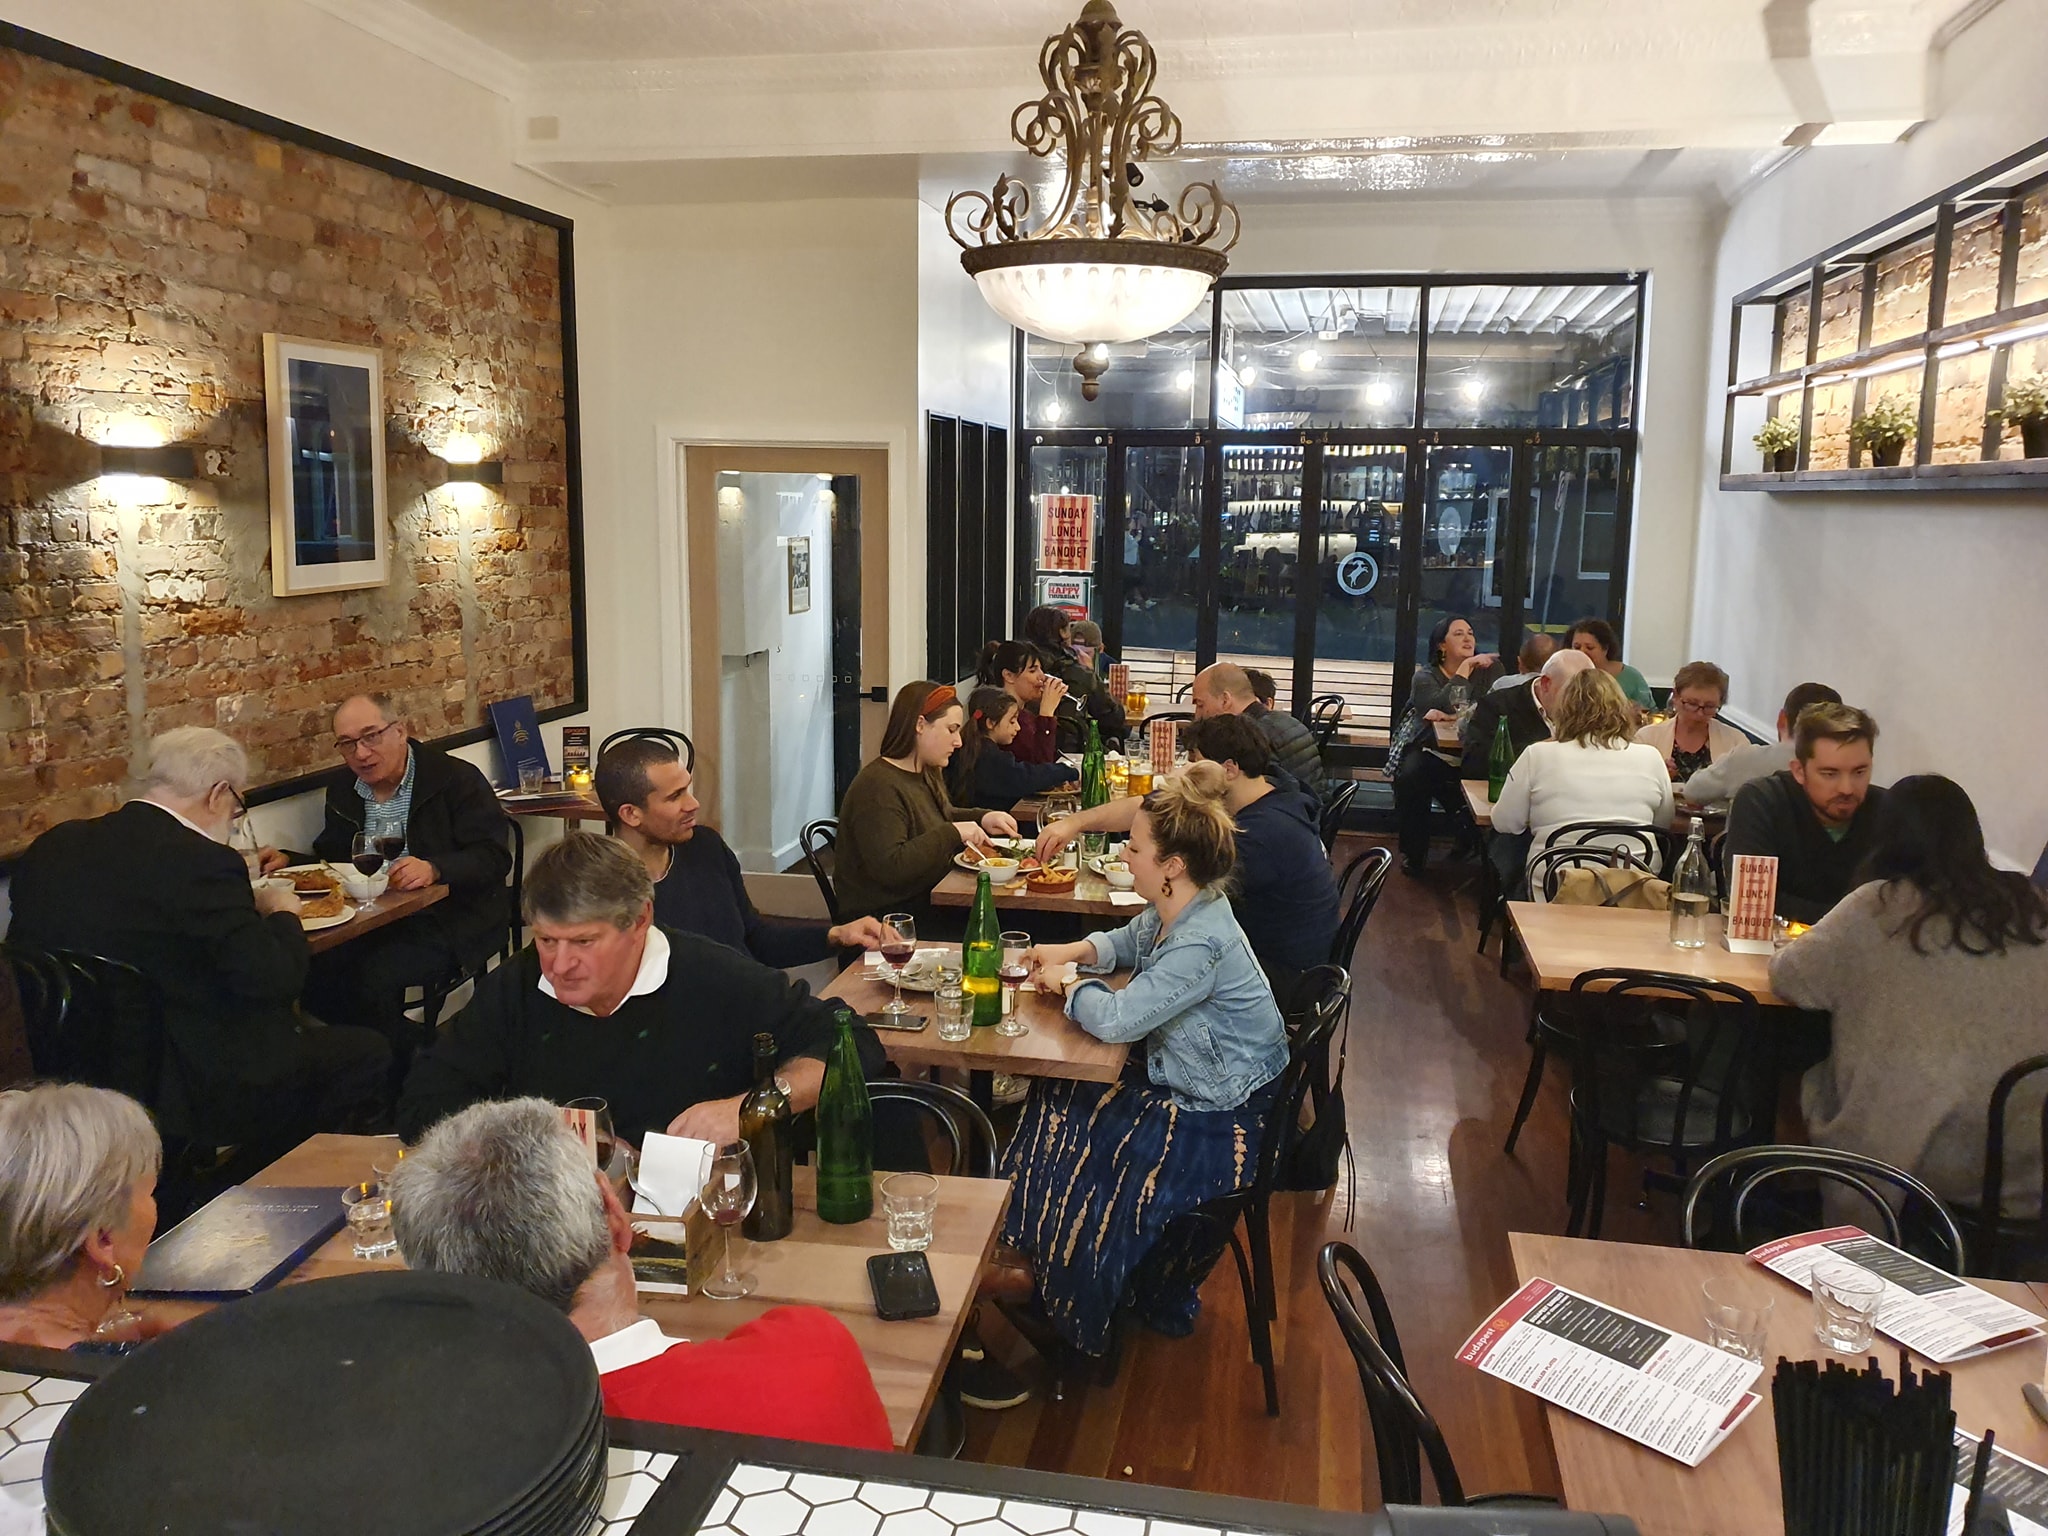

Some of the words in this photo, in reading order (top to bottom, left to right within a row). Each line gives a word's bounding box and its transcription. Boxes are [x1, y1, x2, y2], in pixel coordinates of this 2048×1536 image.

[1048, 507, 1087, 519] SUNDAY
[1051, 526, 1082, 538] LUNCH
[1044, 546, 1087, 559] BANQUET
[1048, 586, 1080, 595] HAPPY
[1739, 863, 1774, 875] SUNDAY
[1740, 889, 1770, 899] LUNCH
[1732, 916, 1773, 928] BANQUET
[1753, 1242, 1791, 1259] budapest
[1463, 1328, 1496, 1361] budapest
